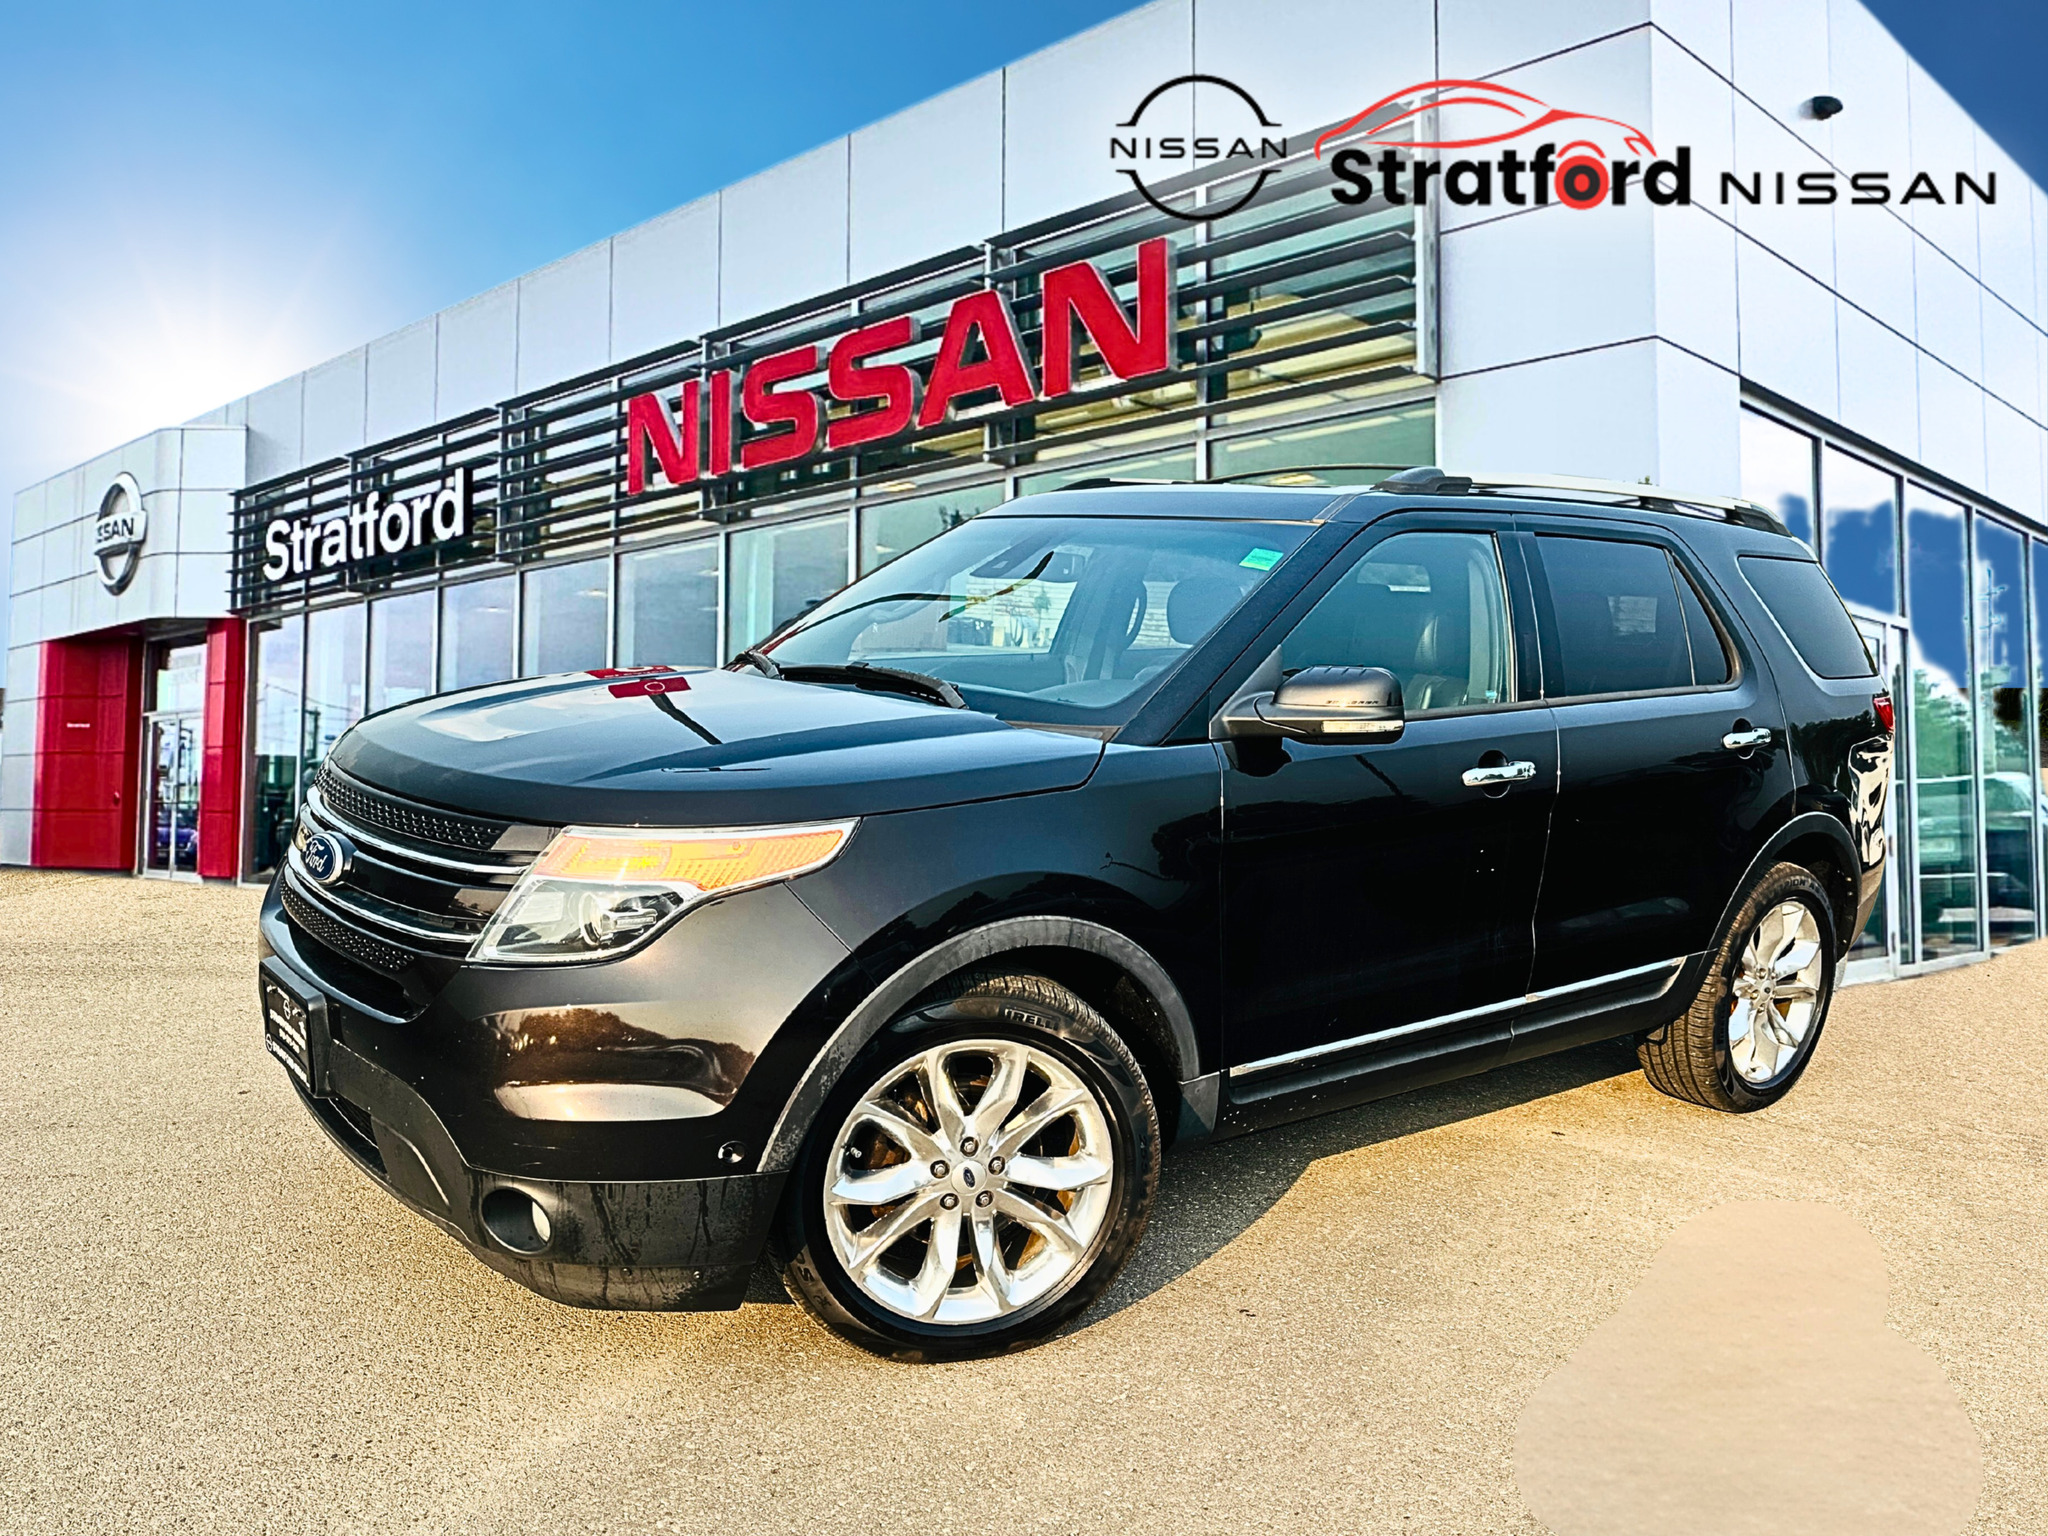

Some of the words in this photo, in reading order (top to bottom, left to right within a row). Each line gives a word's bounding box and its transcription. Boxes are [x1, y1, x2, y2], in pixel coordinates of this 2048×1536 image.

[626, 236, 1171, 496] NISSAN
[262, 466, 466, 581] Stratford
[304, 839, 328, 873] Ford
